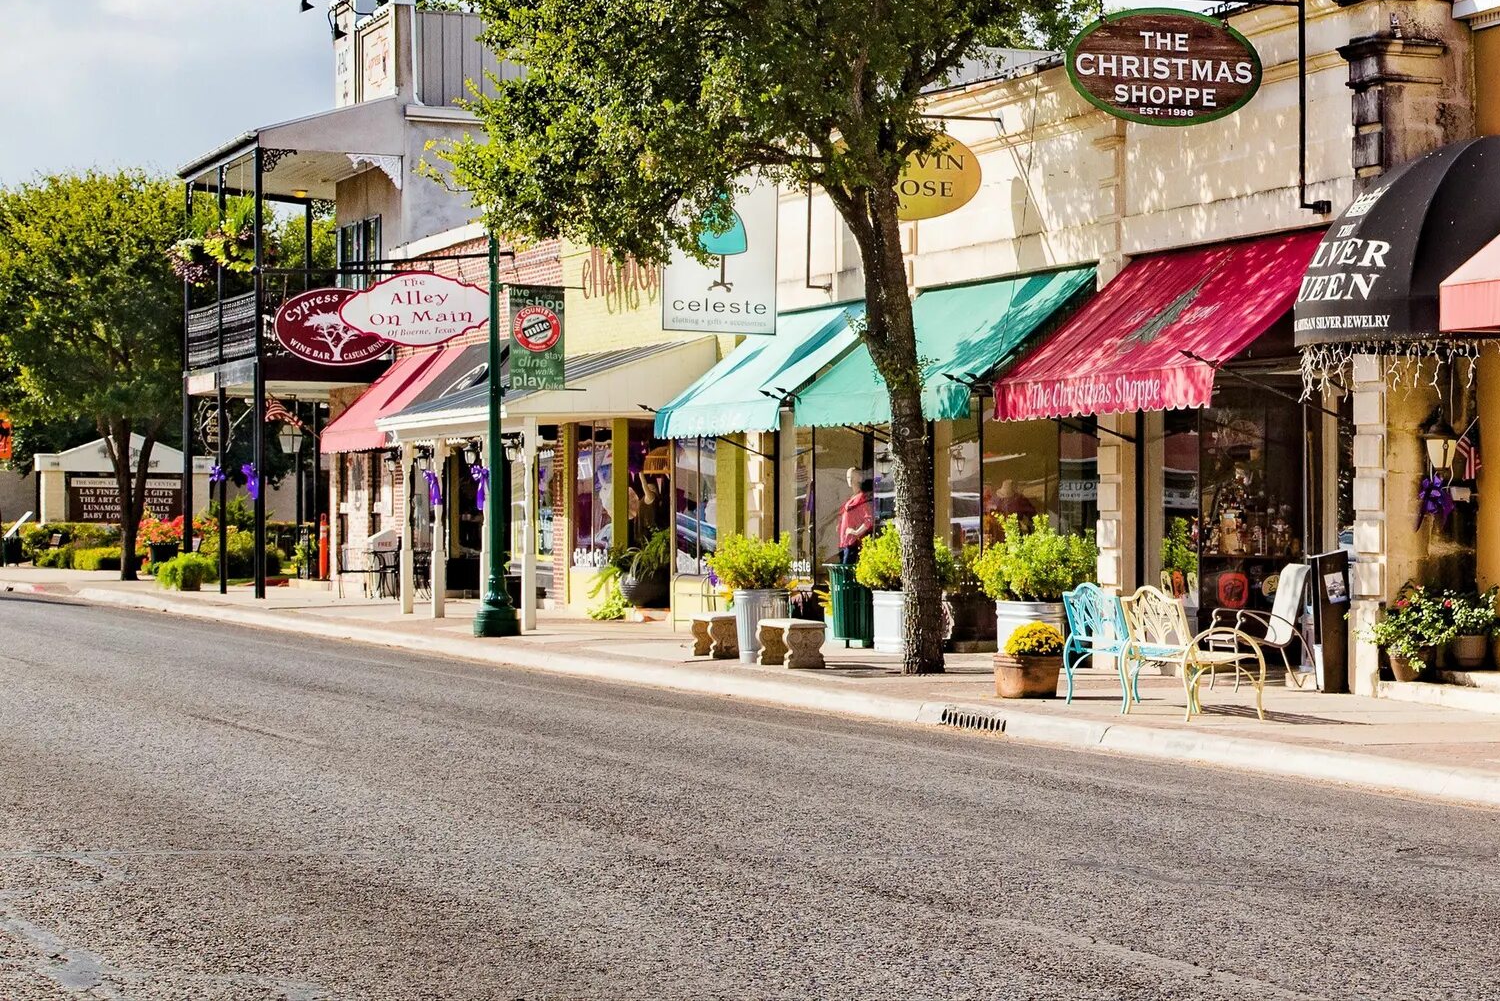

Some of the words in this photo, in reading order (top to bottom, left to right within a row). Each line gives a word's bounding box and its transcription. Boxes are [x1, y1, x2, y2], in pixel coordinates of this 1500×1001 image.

[1139, 30, 1189, 52] THE
[1076, 53, 1252, 84] CHRISTMAS
[1114, 84, 1217, 107] SHOPPE
[1140, 106, 1164, 116] EST.
[1168, 108, 1194, 117] 1996
[914, 154, 965, 170] VIN
[900, 180, 954, 198] OSE
[1308, 238, 1390, 268] LVER
[400, 278, 425, 287] The
[1298, 272, 1380, 302] UEEN
[390, 290, 448, 306] Alley
[526, 296, 564, 312] shop
[672, 298, 767, 314] celeste
[285, 294, 338, 322] Cypress
[370, 312, 400, 326] On
[412, 310, 474, 324] Main
[672, 316, 699, 326] clothing
[1342, 314, 1390, 328] JEWELRY
[434, 326, 456, 334] Texas
[290, 338, 312, 355] WINE
[312, 348, 330, 360] BAR
[343, 348, 368, 360] CASUAL
[544, 352, 564, 362] stay
[518, 356, 548, 368] dine
[512, 374, 547, 390] play
[1031, 382, 1050, 410] The
[1052, 379, 1112, 407] Christmas
[1115, 374, 1160, 407] Shoppe
